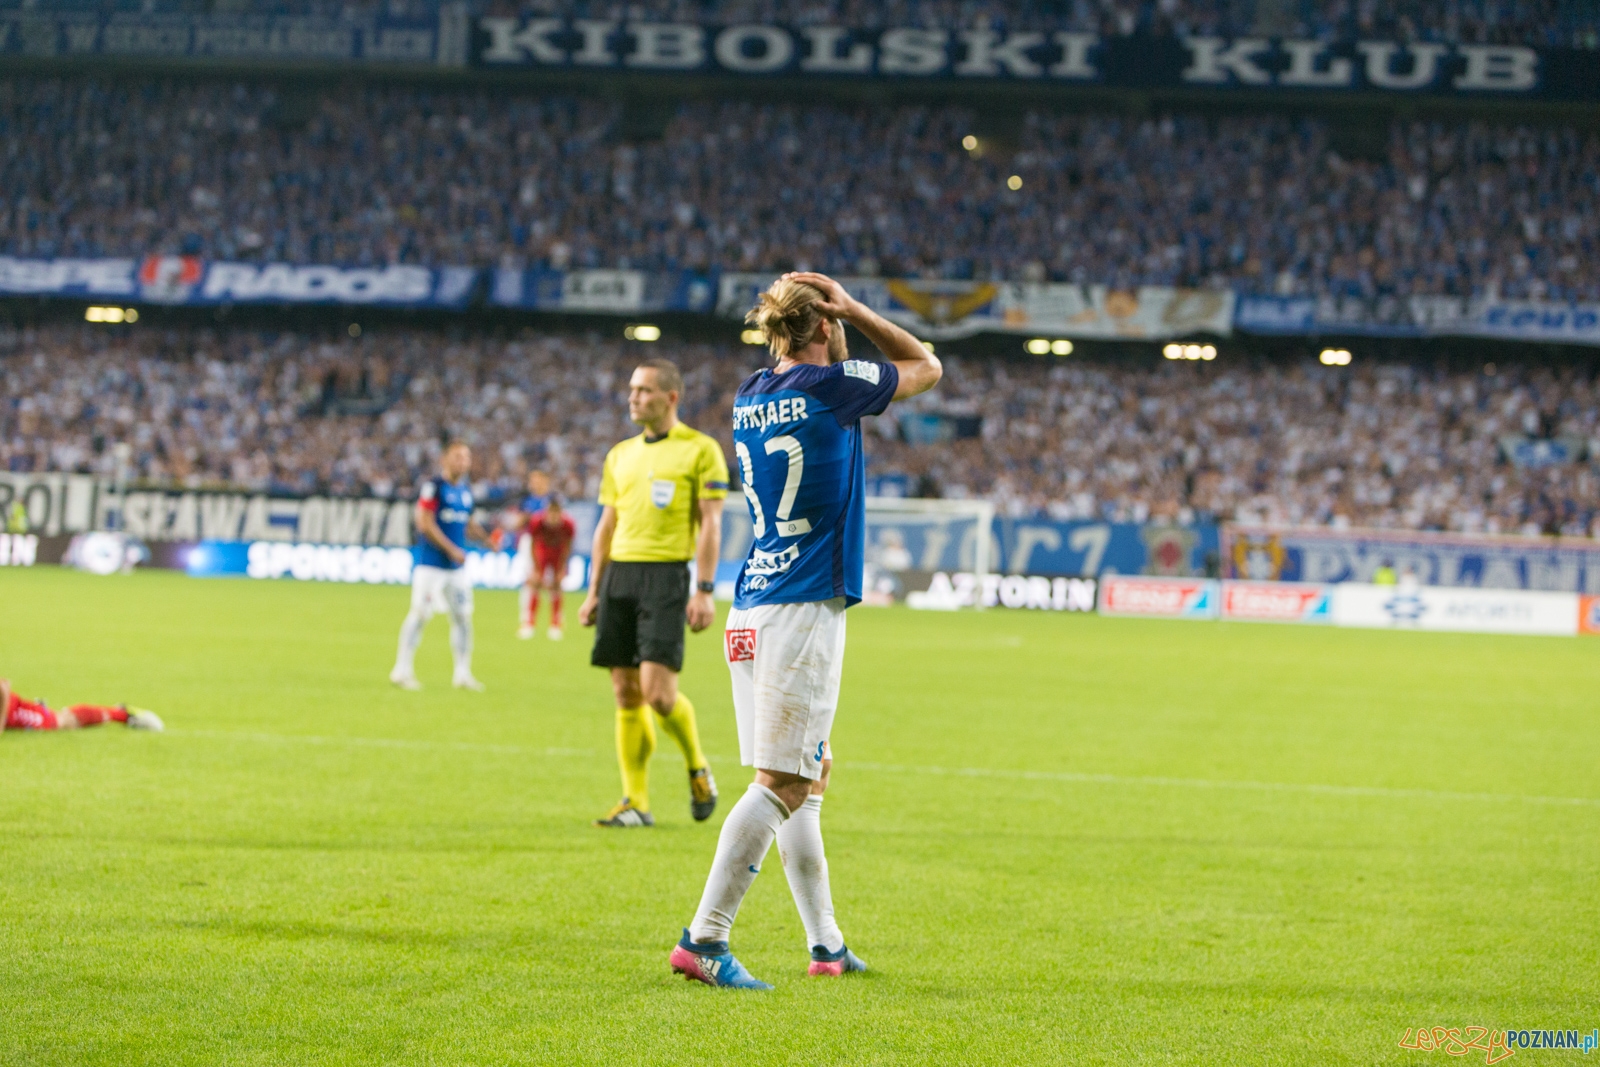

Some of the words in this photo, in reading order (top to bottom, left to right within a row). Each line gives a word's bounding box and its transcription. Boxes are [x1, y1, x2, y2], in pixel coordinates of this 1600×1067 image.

[478, 16, 1099, 79] KIBOLSKI
[1182, 36, 1540, 91] KLUB
[735, 434, 812, 539] 32
[247, 541, 413, 585] SPONSOR
